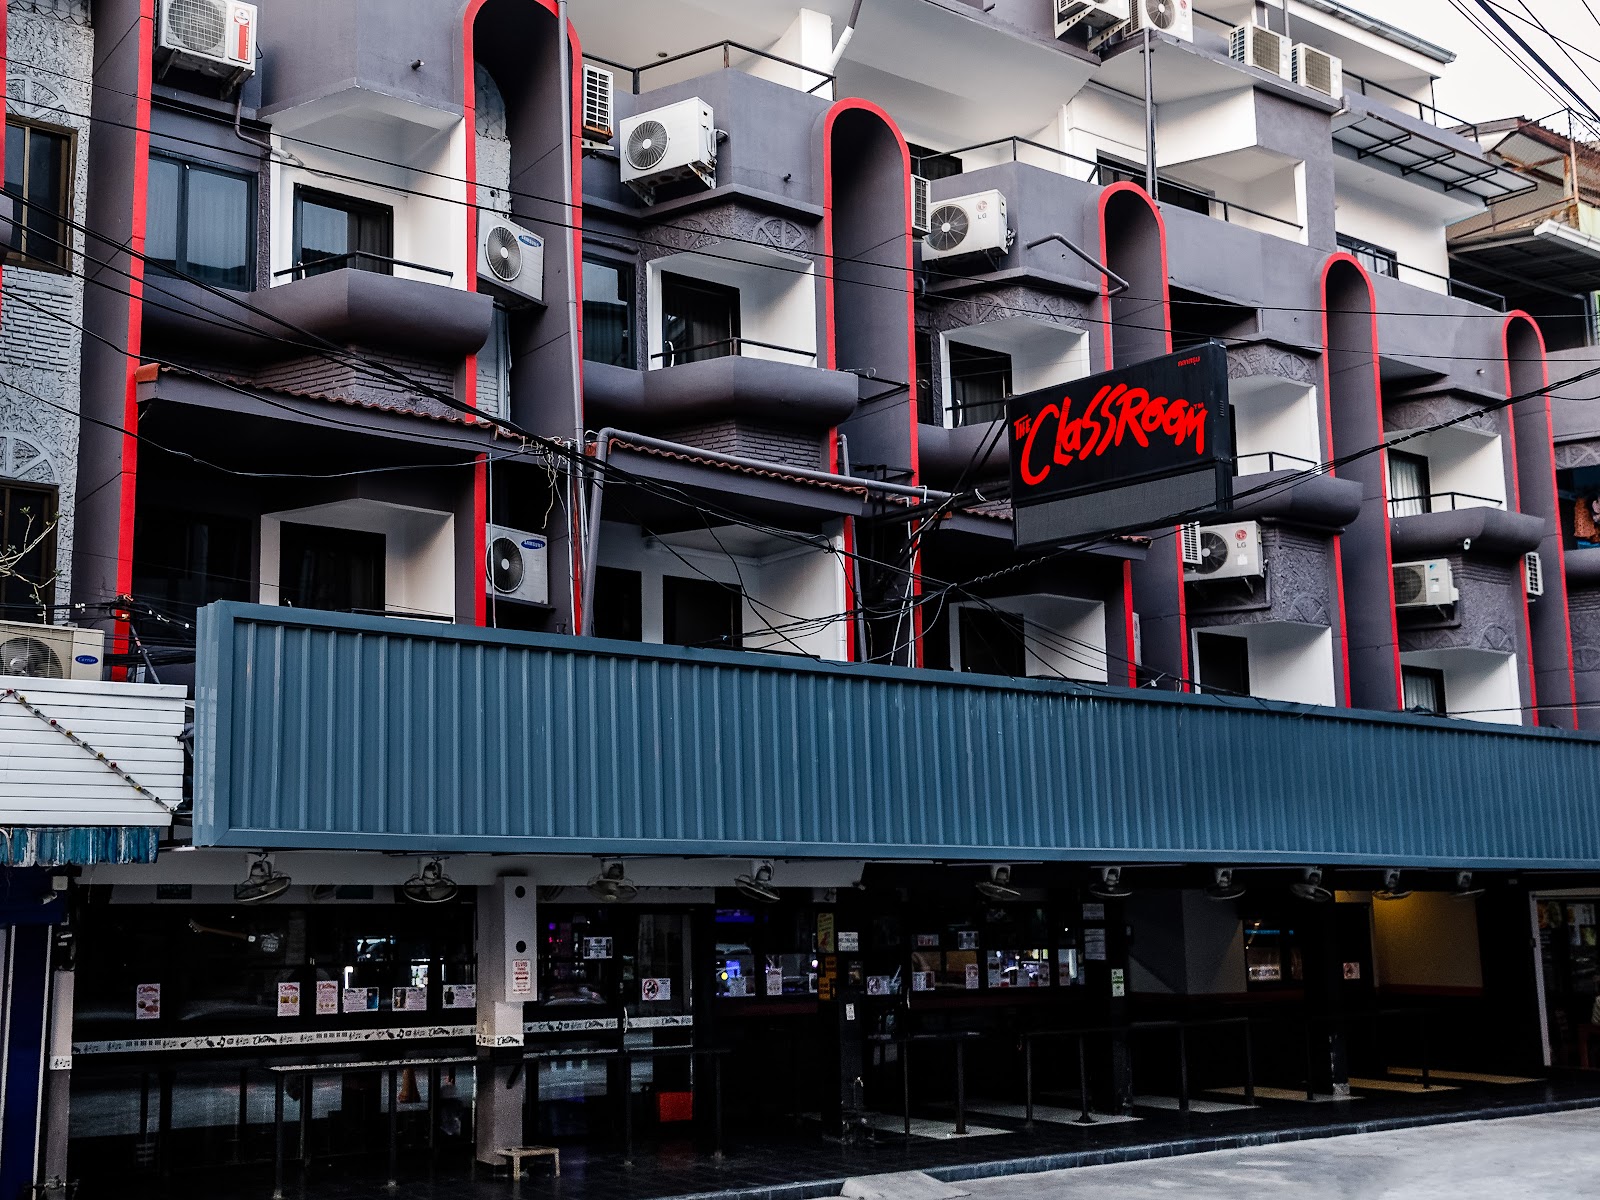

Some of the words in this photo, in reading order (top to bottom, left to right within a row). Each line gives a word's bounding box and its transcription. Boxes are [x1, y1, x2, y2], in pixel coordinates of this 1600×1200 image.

[977, 212, 987, 220] LG
[1013, 414, 1031, 440] THE
[522, 538, 544, 548] SAMSUNG
[1236, 541, 1247, 549] LG
